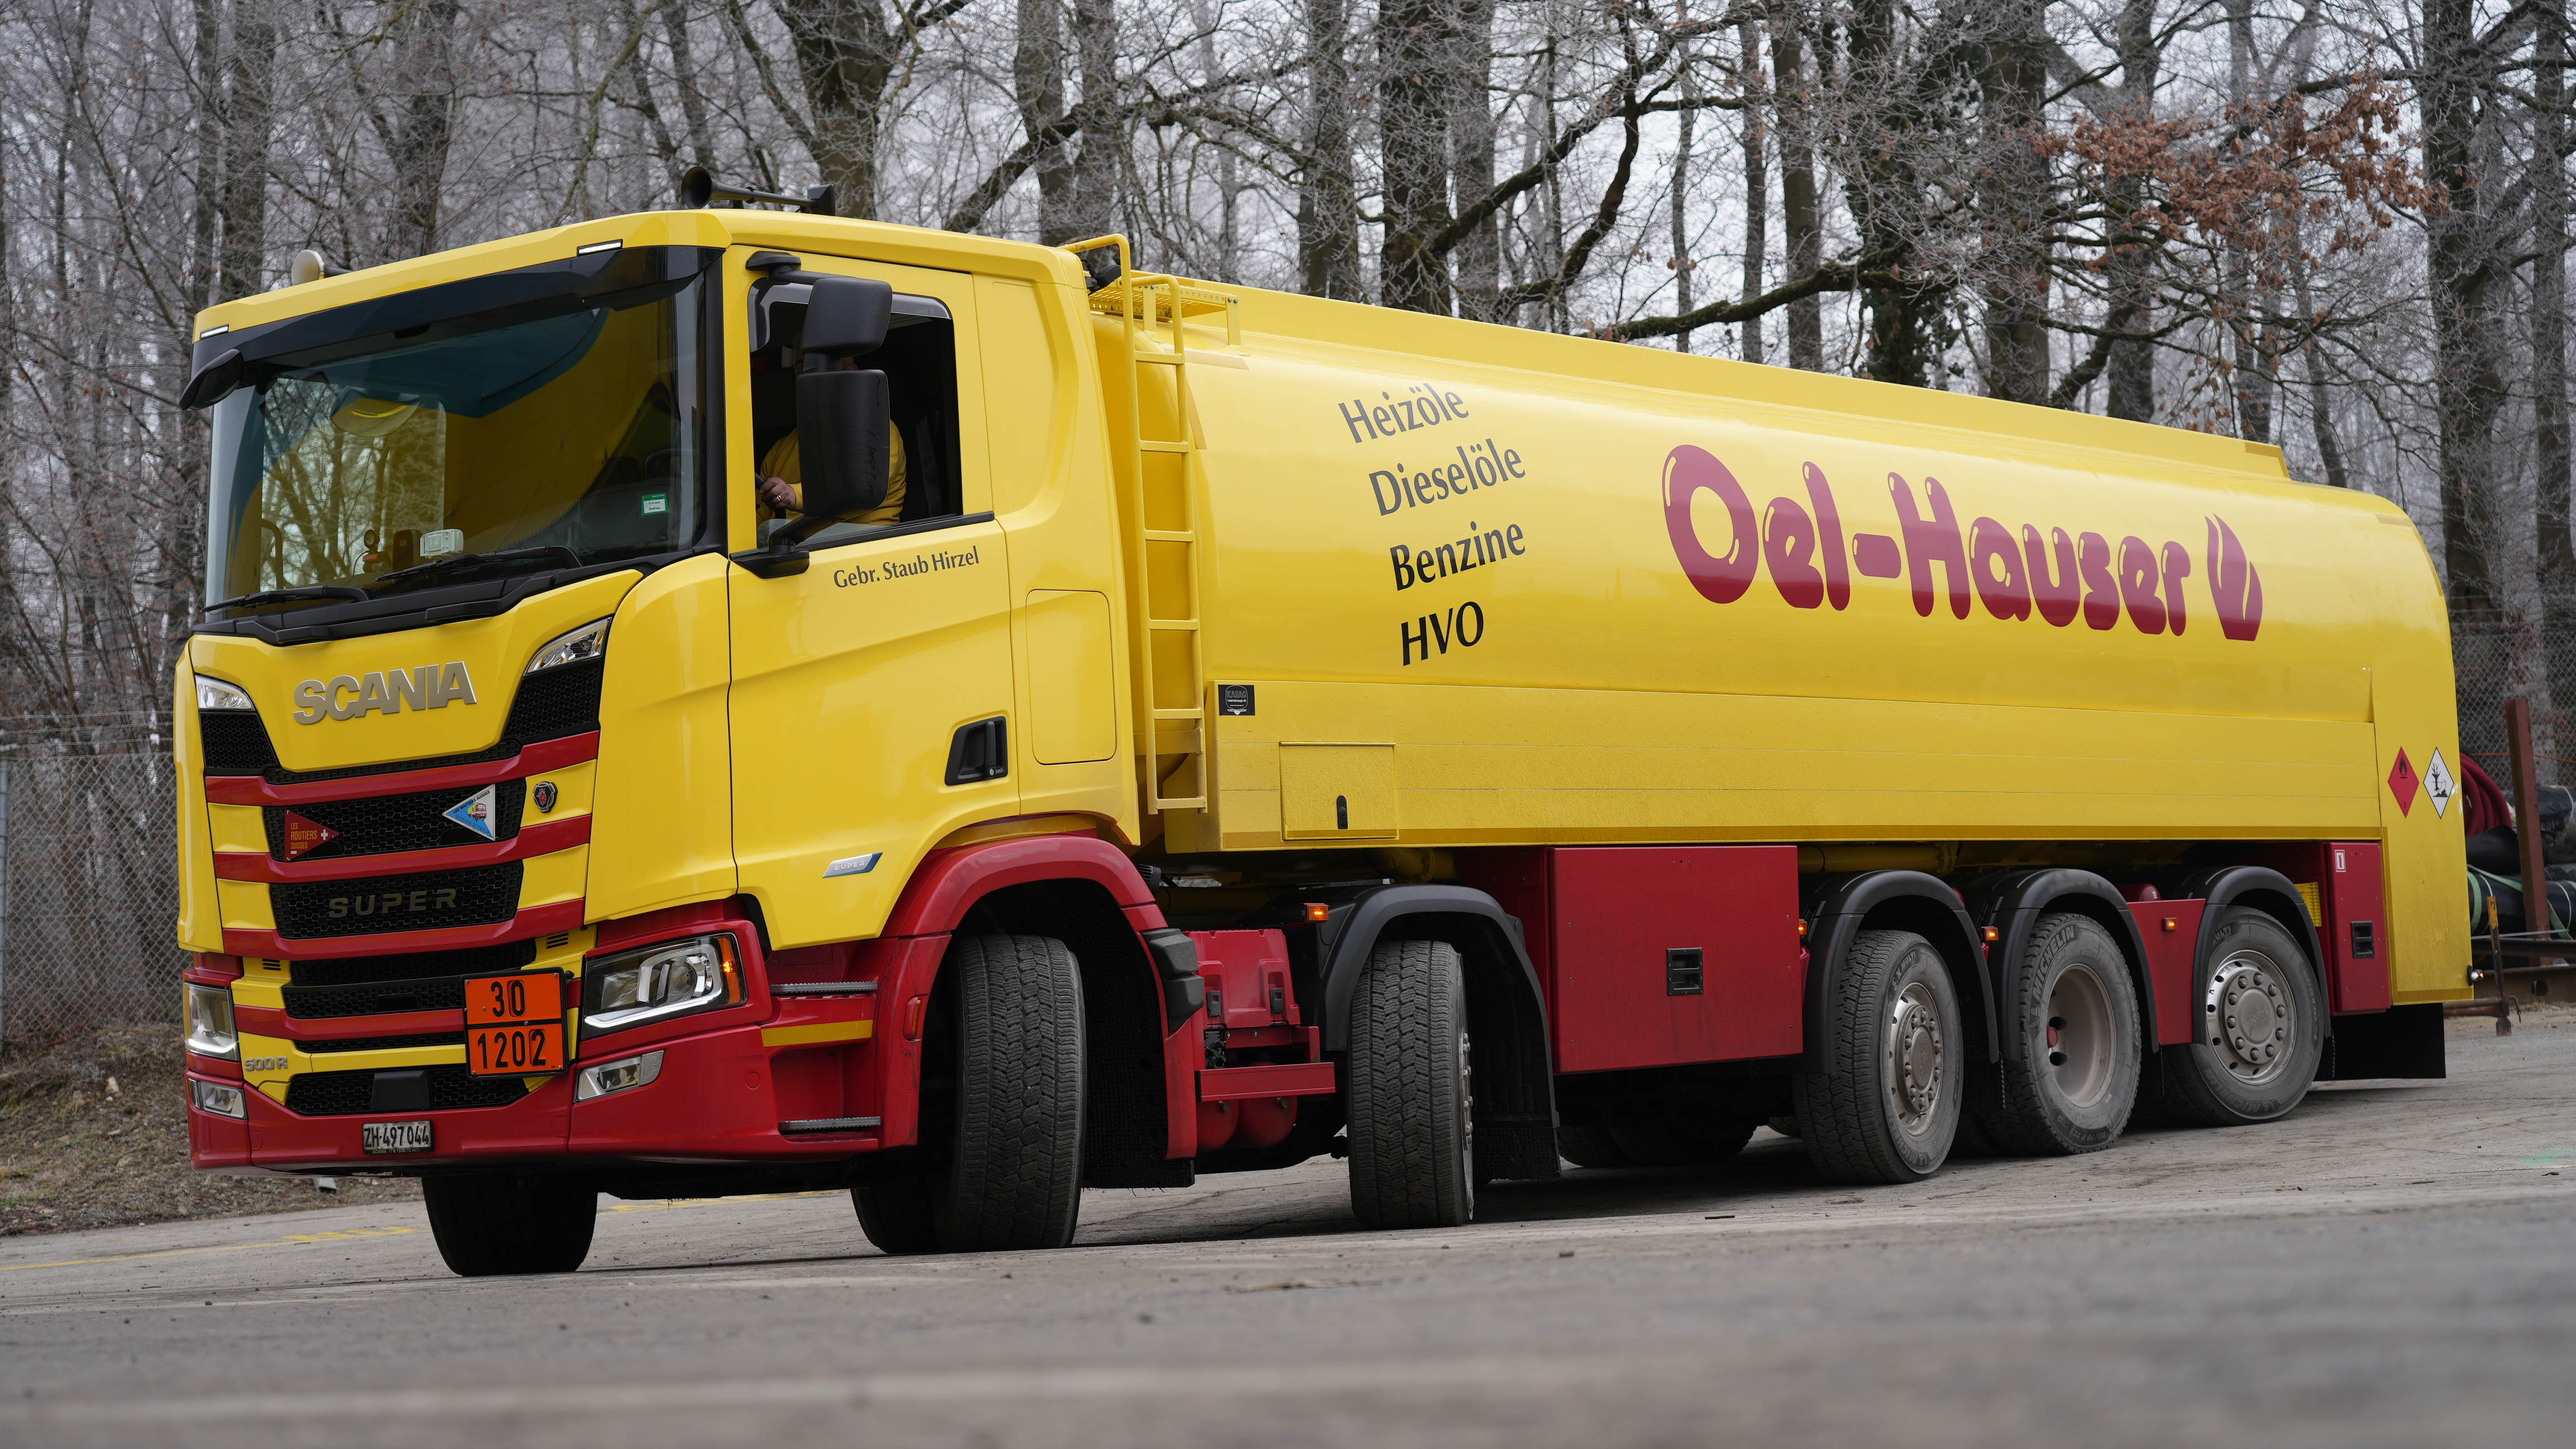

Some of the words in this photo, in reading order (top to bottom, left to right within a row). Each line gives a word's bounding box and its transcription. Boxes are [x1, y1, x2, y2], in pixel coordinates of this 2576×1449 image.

[1338, 383, 1469, 443] Heizöle
[1368, 438, 1526, 516] Dieselöle
[1390, 521, 1526, 591] Benzine
[1662, 444, 2191, 636] Oel-Hauser
[834, 565, 880, 588] Gebr.
[883, 555, 929, 580] Staub
[931, 546, 979, 571] Hirzel
[1401, 602, 1484, 666] HVO
[292, 660, 477, 725] SCANIA
[460, 798, 476, 810] ROUTIERS
[476, 790, 490, 801] SUISSES
[291, 830, 317, 840] ROUTIERS
[834, 861, 864, 870] SUPER
[329, 888, 456, 918] SUPER
[2033, 925, 2075, 1002] MICHELIN
[491, 981, 525, 1017] 30
[477, 1030, 546, 1069] 1202
